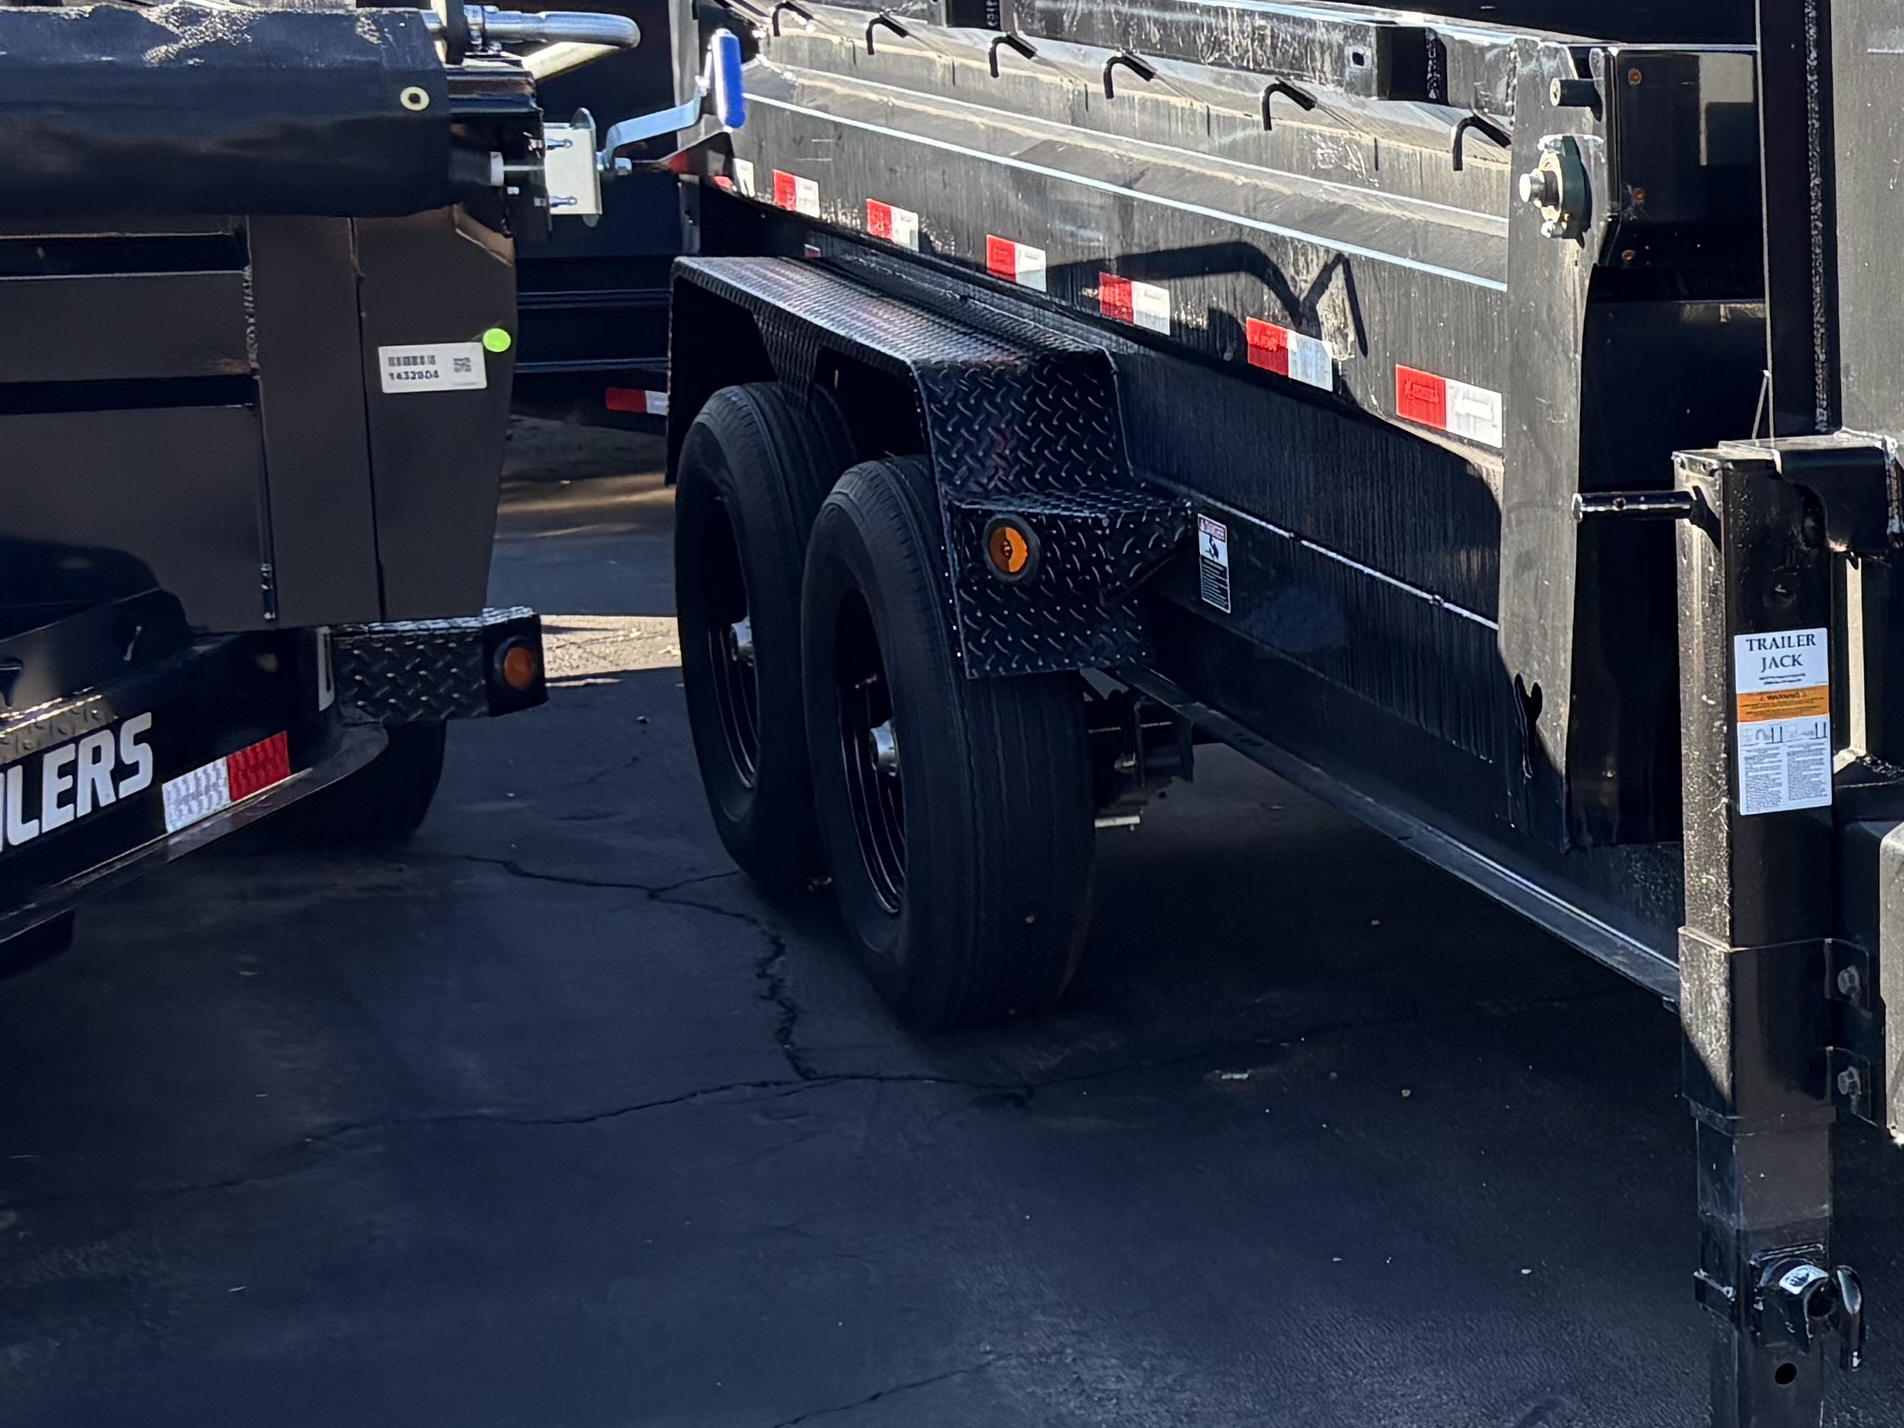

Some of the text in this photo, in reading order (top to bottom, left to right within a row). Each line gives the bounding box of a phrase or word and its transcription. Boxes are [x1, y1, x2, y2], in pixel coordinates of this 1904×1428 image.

[1745, 633, 1817, 652] TRAILER
[1760, 653, 1803, 673] JACK
[0, 711, 154, 854] LERS
